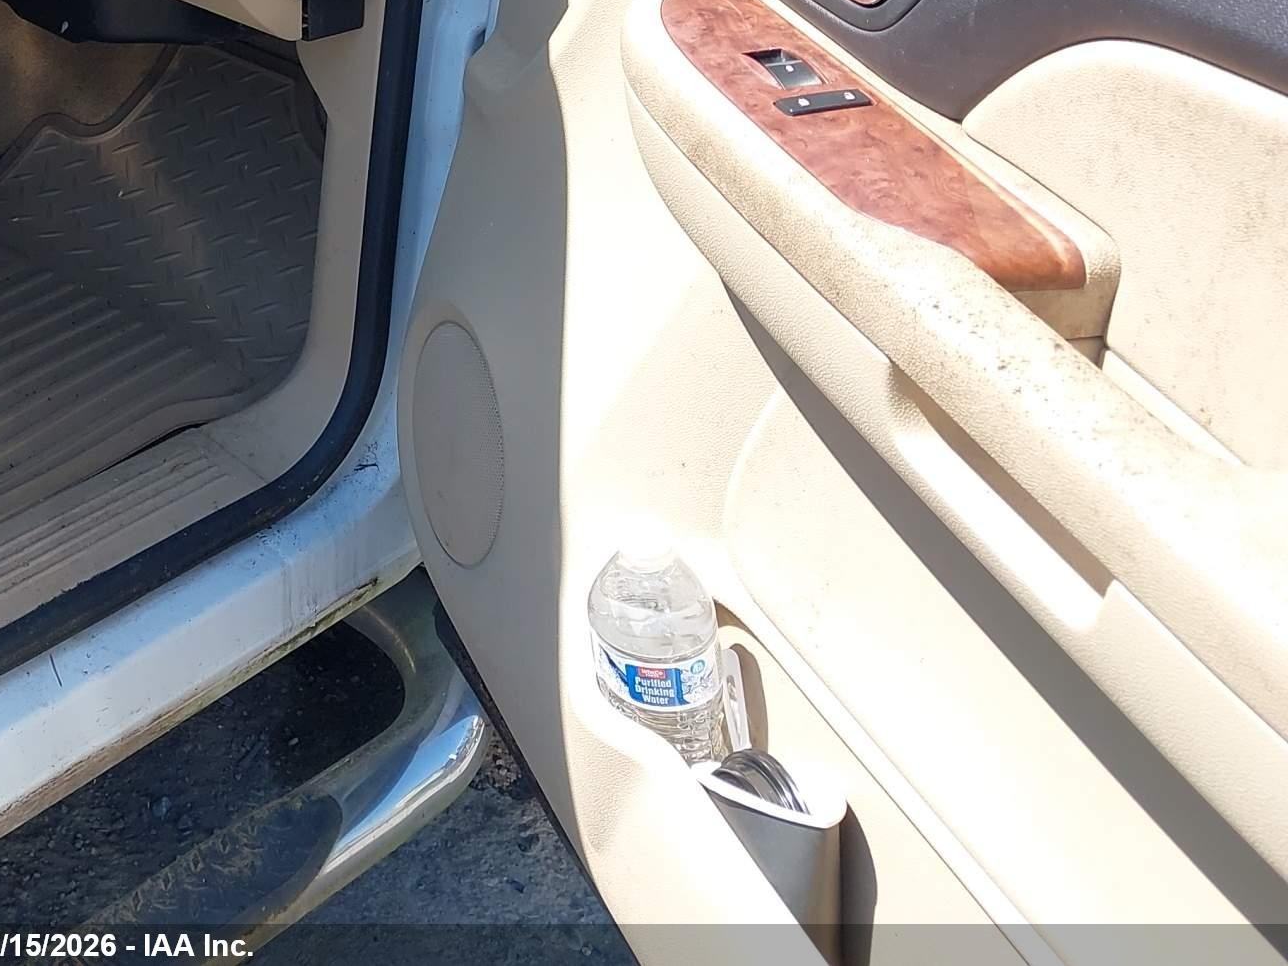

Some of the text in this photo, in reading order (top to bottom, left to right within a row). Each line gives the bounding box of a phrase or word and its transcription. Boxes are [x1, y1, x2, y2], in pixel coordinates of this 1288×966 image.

[634, 676, 672, 688] Purified
[634, 684, 675, 698] Drinking
[641, 693, 670, 705] Water
